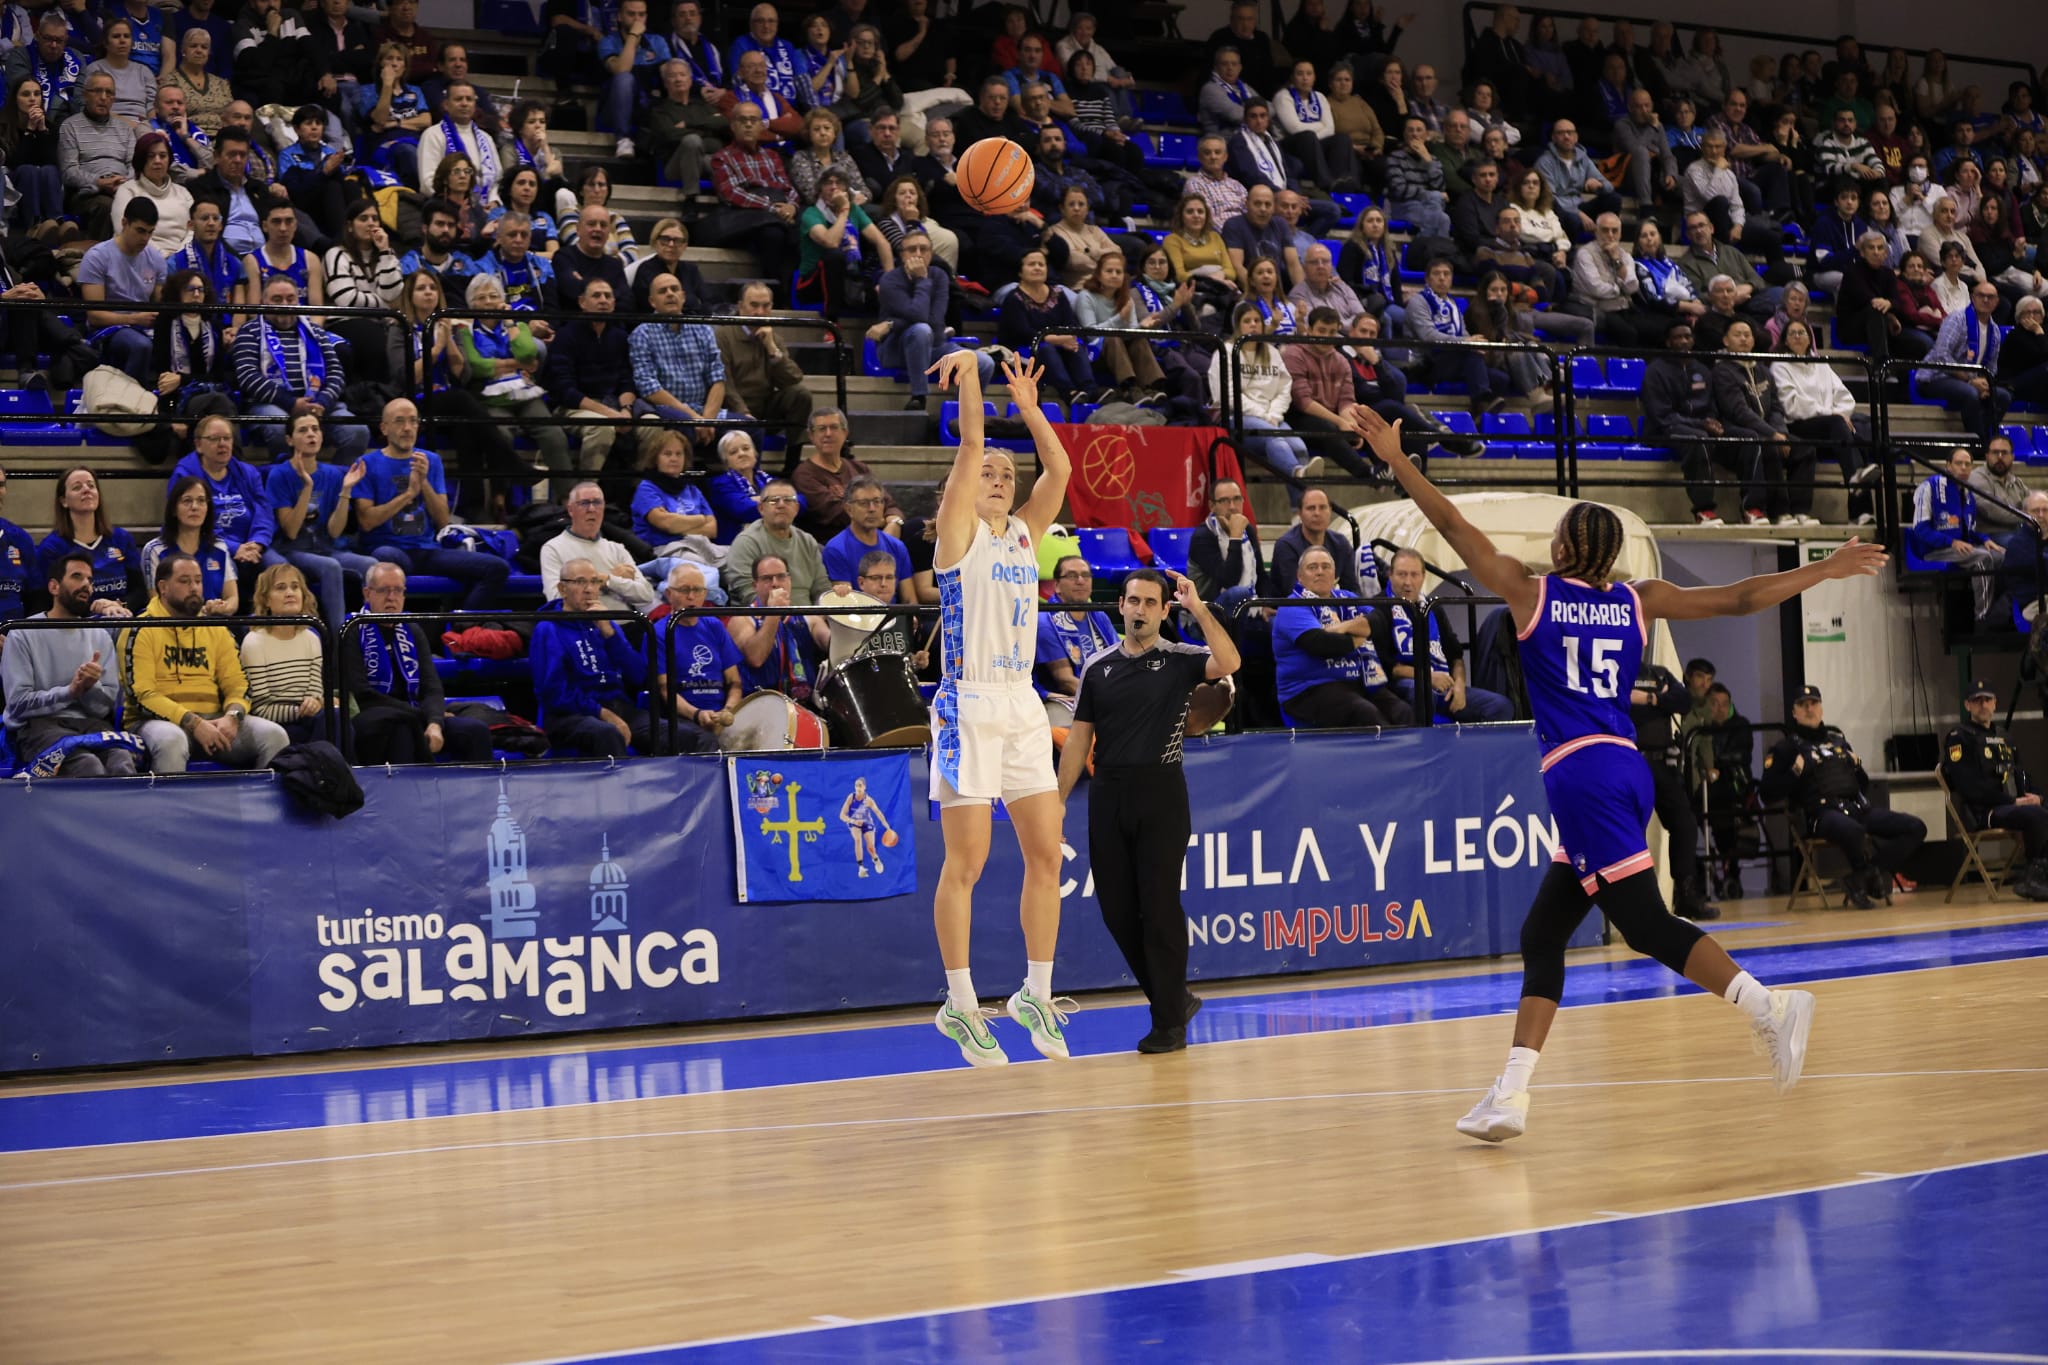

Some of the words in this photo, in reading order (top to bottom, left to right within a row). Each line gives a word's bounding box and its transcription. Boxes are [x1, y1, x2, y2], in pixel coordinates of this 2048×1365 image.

[1551, 600, 1631, 627] RICKARDS
[1562, 636, 1623, 698] 15
[1358, 822, 1398, 891] Y
[1424, 794, 1560, 874] LEÓN
[316, 908, 444, 947] turismo
[1188, 912, 1256, 947] NOS
[1263, 899, 1433, 957] IMPULSA
